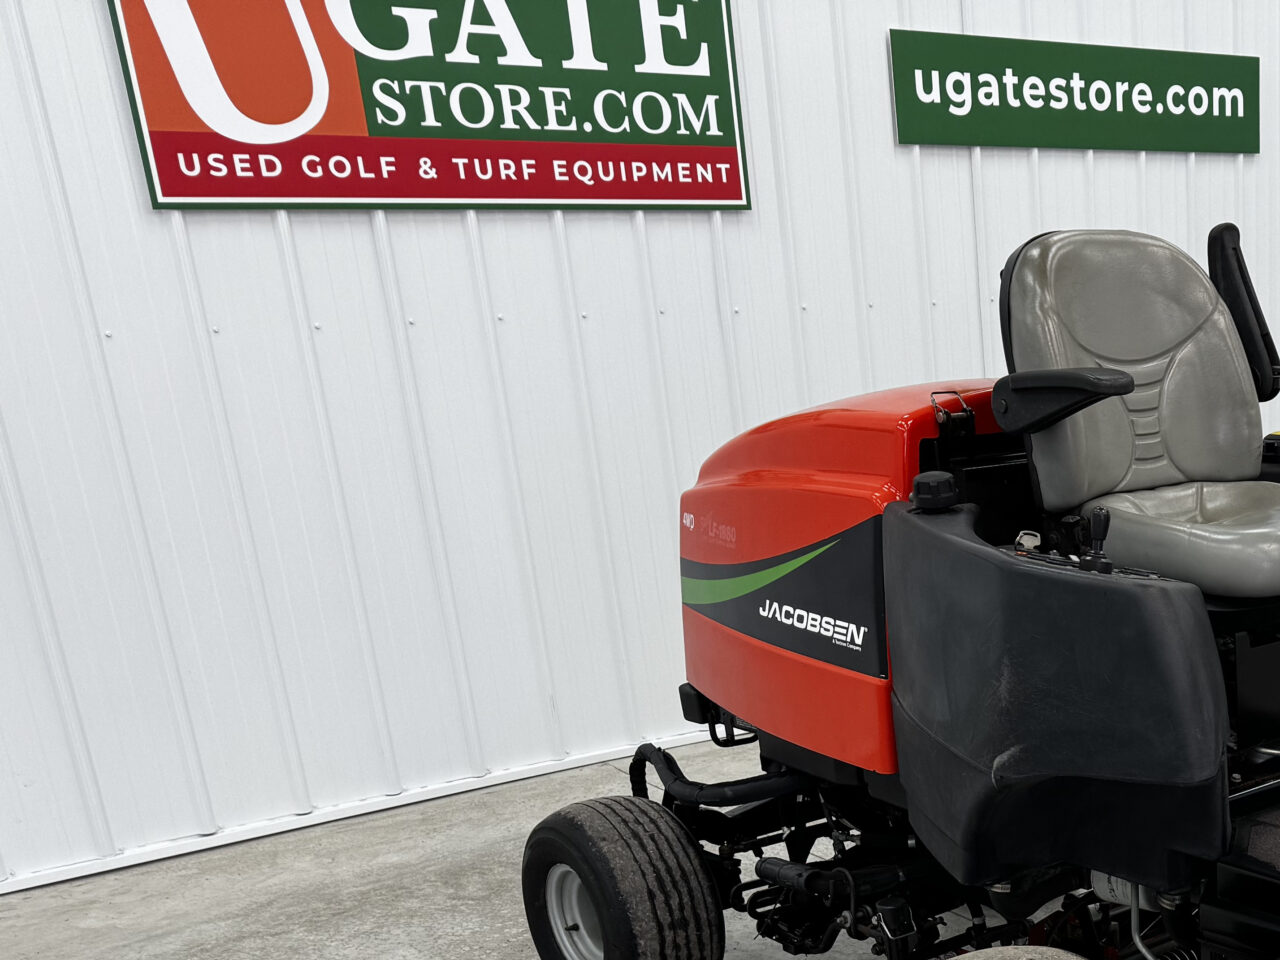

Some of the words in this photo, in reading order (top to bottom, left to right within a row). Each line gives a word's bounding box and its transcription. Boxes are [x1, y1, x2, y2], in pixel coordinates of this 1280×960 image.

[372, 77, 724, 136] STORE.COM
[914, 67, 1244, 117] ugatestore.com
[177, 152, 283, 178] USED
[301, 154, 396, 179] GOLF
[418, 156, 438, 180] &
[451, 157, 536, 181] TURF
[552, 159, 731, 186] EQUIPMENT
[759, 599, 865, 646] JACOBSEN
